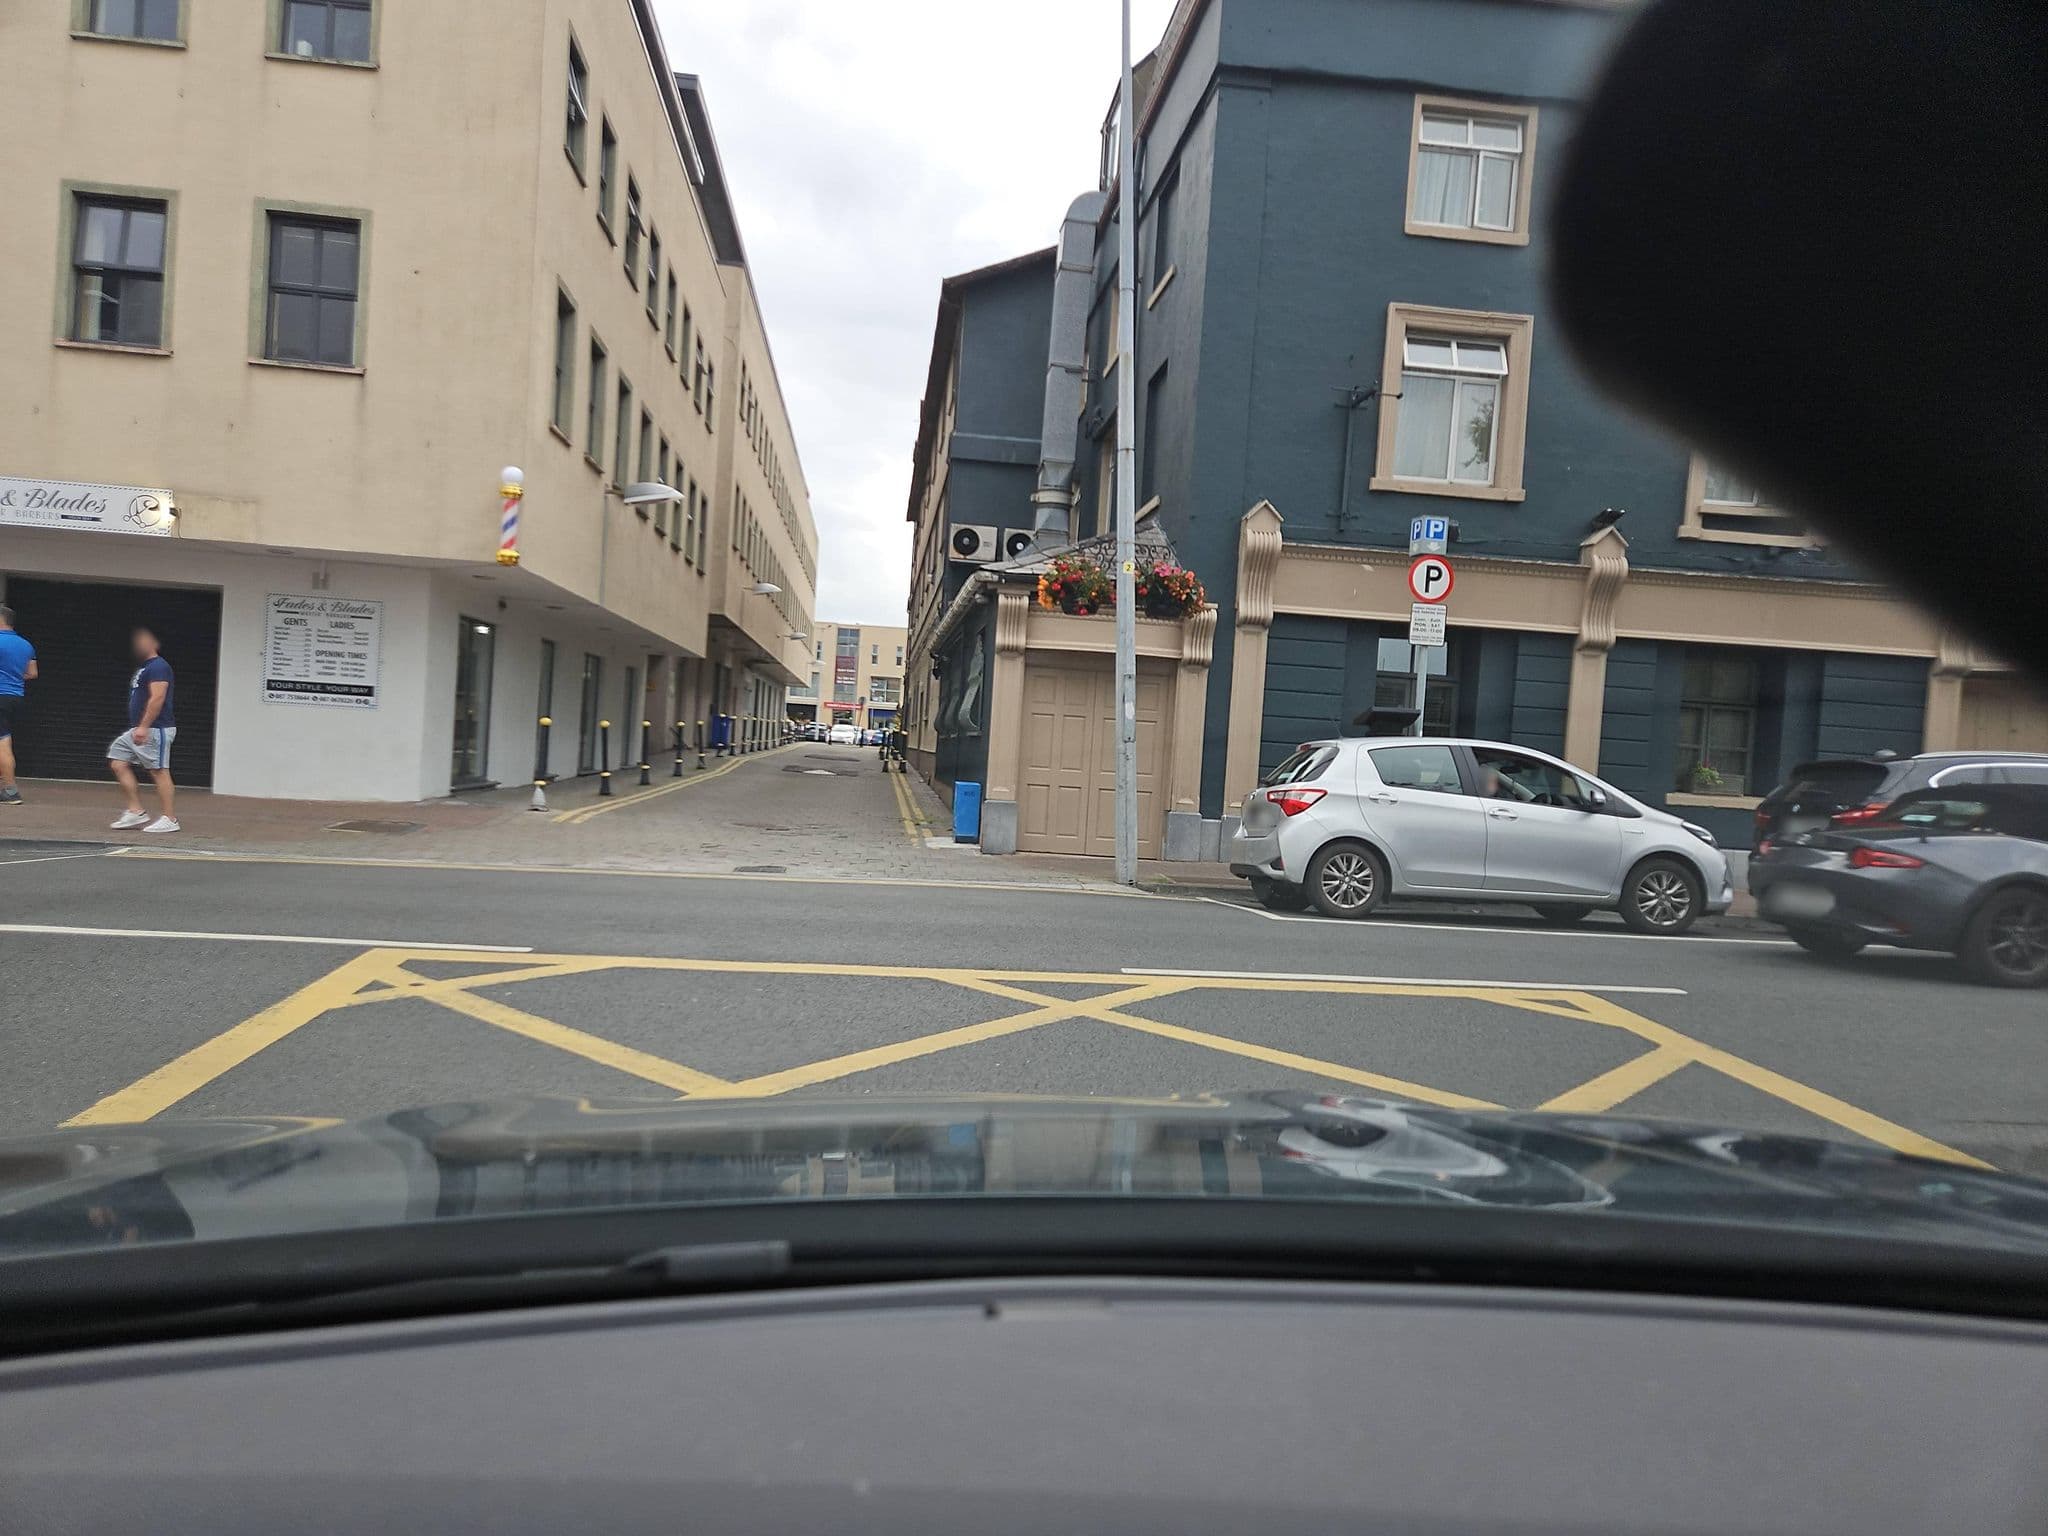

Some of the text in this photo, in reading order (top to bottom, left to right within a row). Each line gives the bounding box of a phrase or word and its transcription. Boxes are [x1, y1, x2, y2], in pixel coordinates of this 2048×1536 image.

[0, 486, 108, 513] & Blades
[1429, 520, 1443, 537] P
[1425, 565, 1443, 593] P
[273, 597, 315, 610] Fades
[317, 603, 325, 612] &
[331, 601, 376, 615] Blades
[284, 617, 308, 627] GENTS
[330, 621, 356, 630] LADIES
[315, 649, 368, 660] OPENING TIMES
[271, 681, 294, 690] YOUR
[326, 684, 349, 693] YOUR
[350, 686, 370, 695] WAY
